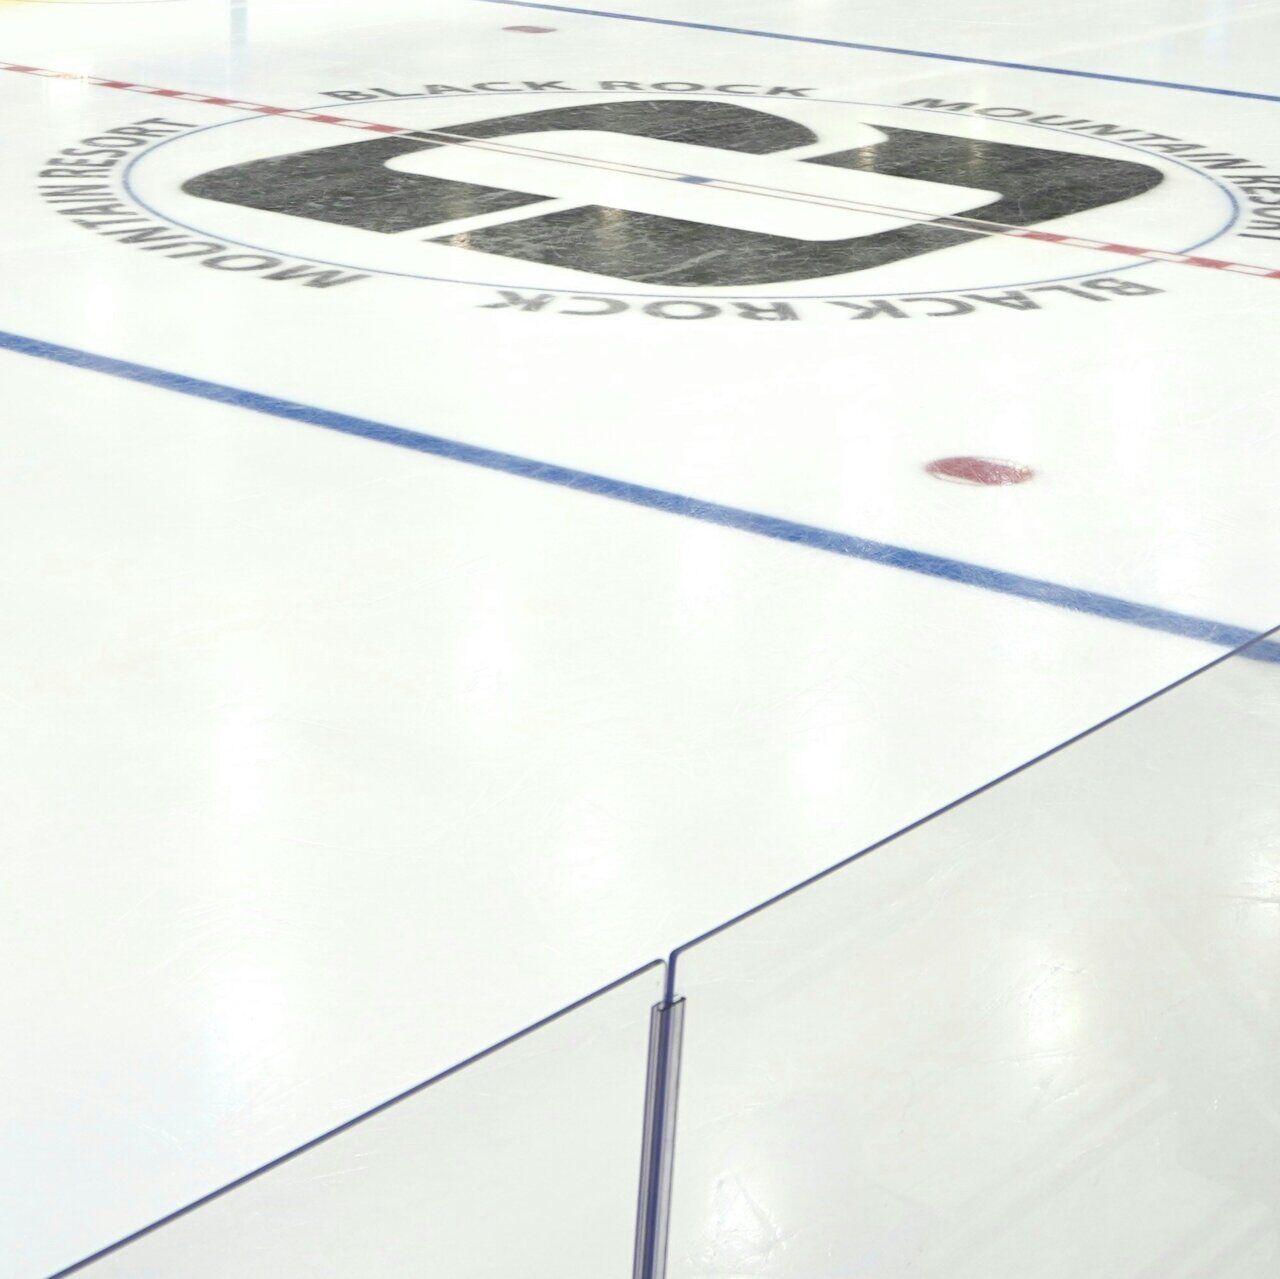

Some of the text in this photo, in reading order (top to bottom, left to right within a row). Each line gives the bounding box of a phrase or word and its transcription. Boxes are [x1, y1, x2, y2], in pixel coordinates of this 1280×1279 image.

[318, 79, 822, 102] BLACK ROCK
[902, 97, 1266, 172] MOUNTAIN
[36, 117, 374, 289] MOUNTAIN RESORT
[474, 277, 1171, 323] BLACK ROCK
